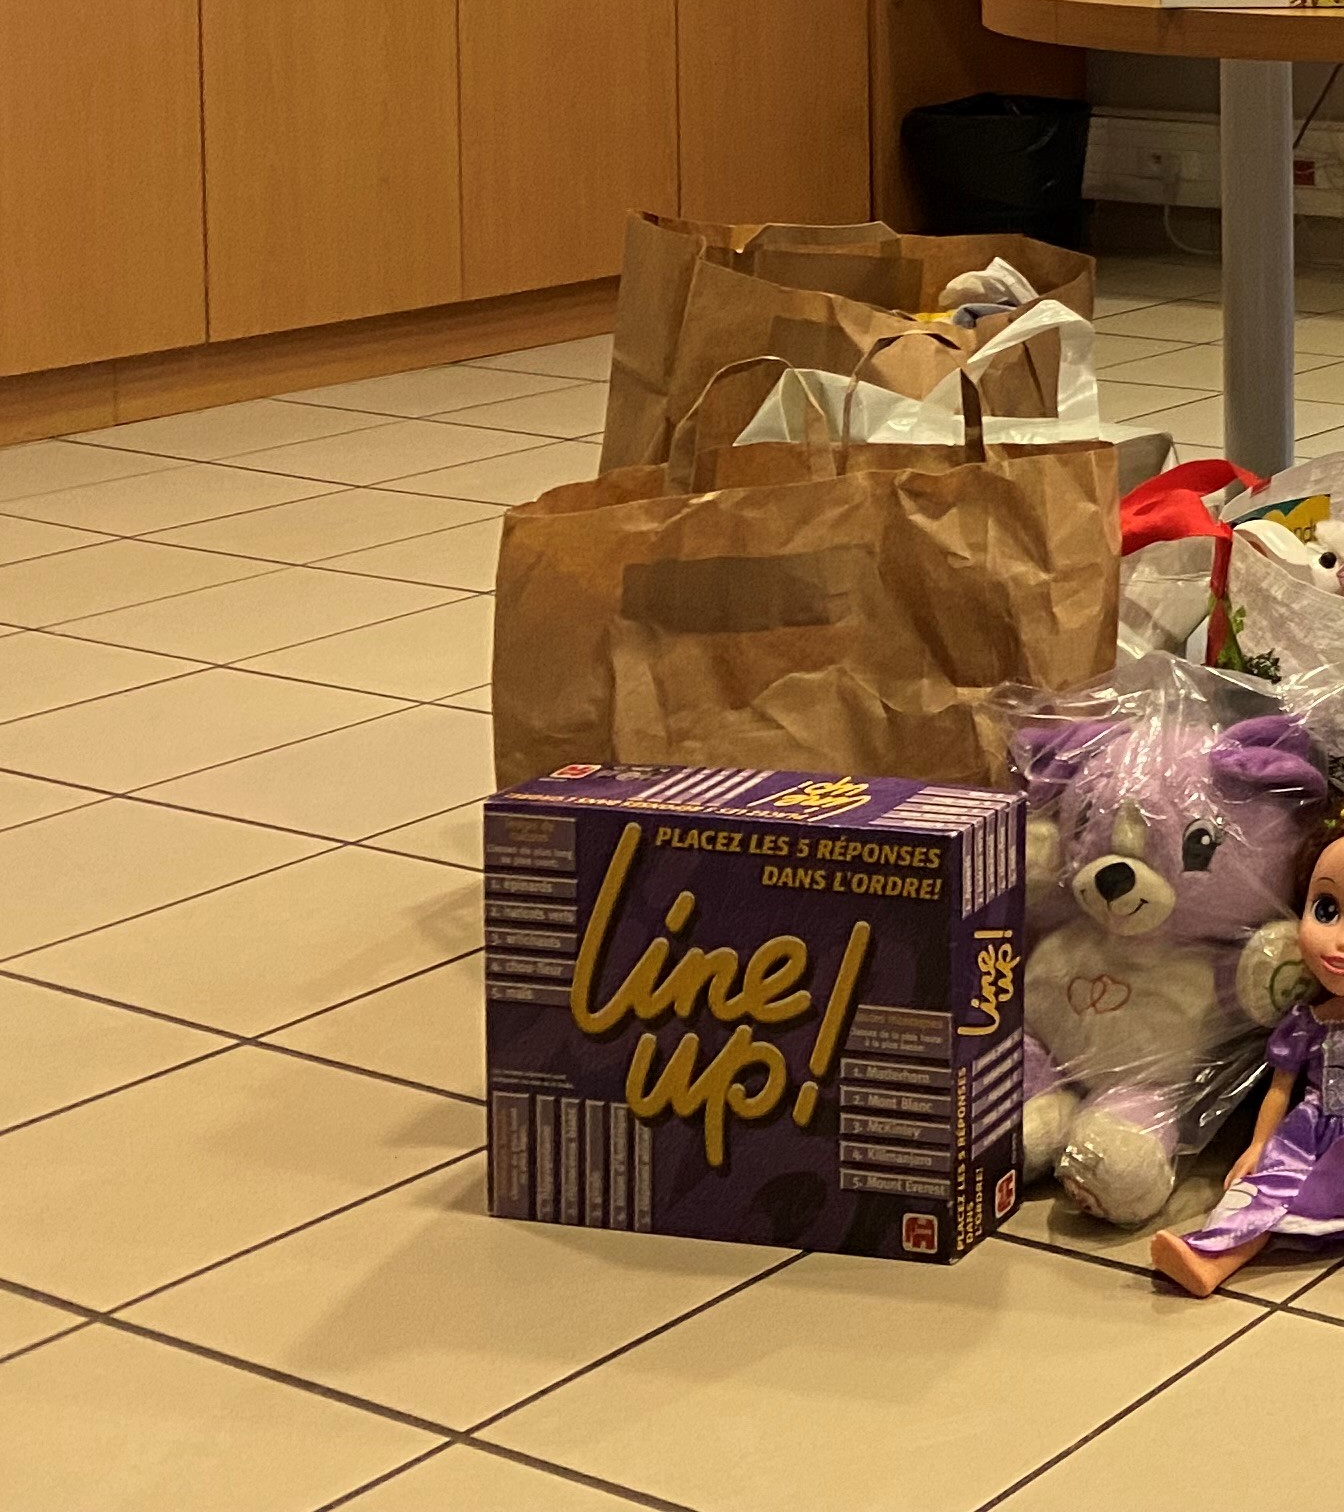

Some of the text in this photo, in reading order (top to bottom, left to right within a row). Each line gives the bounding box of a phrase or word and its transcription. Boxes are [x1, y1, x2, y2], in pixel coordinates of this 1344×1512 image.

[655, 827, 942, 869] PLACEZ LES 5 RÉPONSES
[761, 865, 943, 900] DANS L'ORDRE!
[570, 822, 812, 1035] Line
[957, 944, 1001, 1036] Line
[867, 1094, 897, 1109] Mont
[901, 1098, 934, 1113] Blanc
[956, 1066, 967, 1147] RÉPONSES
[867, 1175, 901, 1190] Mount
[905, 1180, 946, 1197] Everest
[957, 1163, 967, 1191] LES
[956, 1193, 967, 1251] PLACEZ
